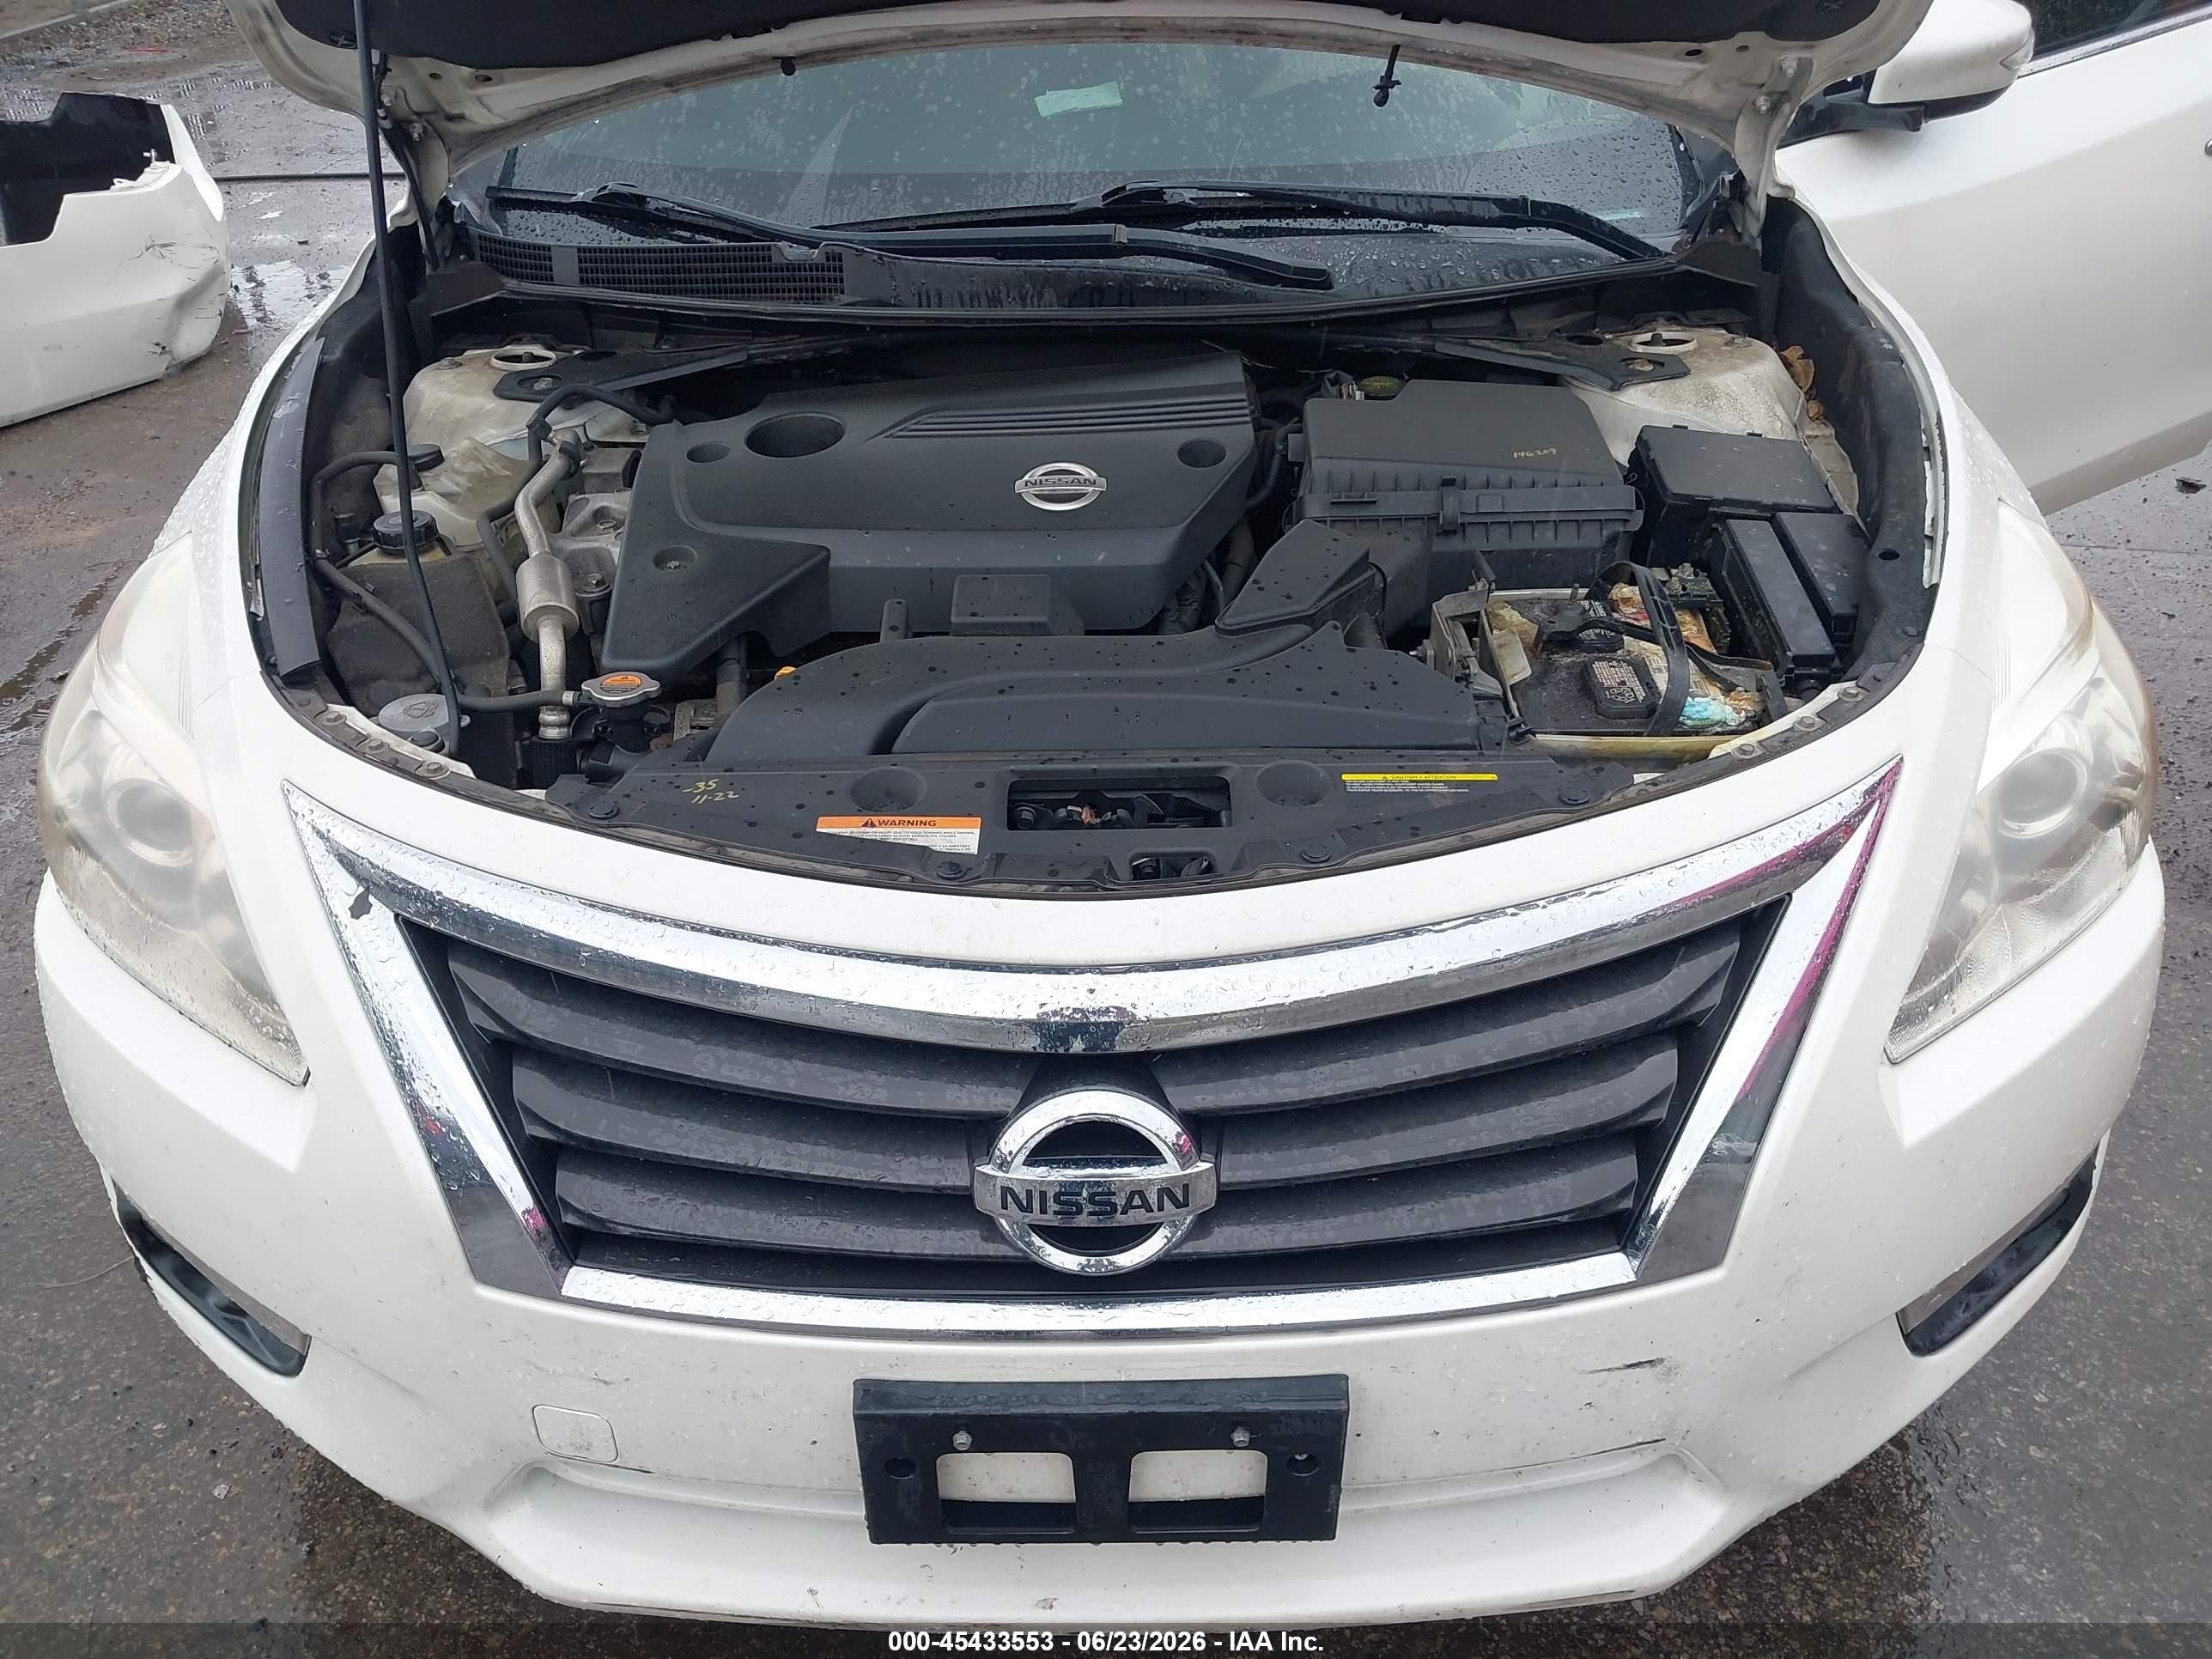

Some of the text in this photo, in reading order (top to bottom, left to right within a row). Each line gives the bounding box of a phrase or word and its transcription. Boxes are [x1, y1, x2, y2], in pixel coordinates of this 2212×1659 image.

[1024, 477, 1097, 487] NISSAN
[878, 818, 937, 827] WARNING
[1000, 1182, 1191, 1218] NISSAN
